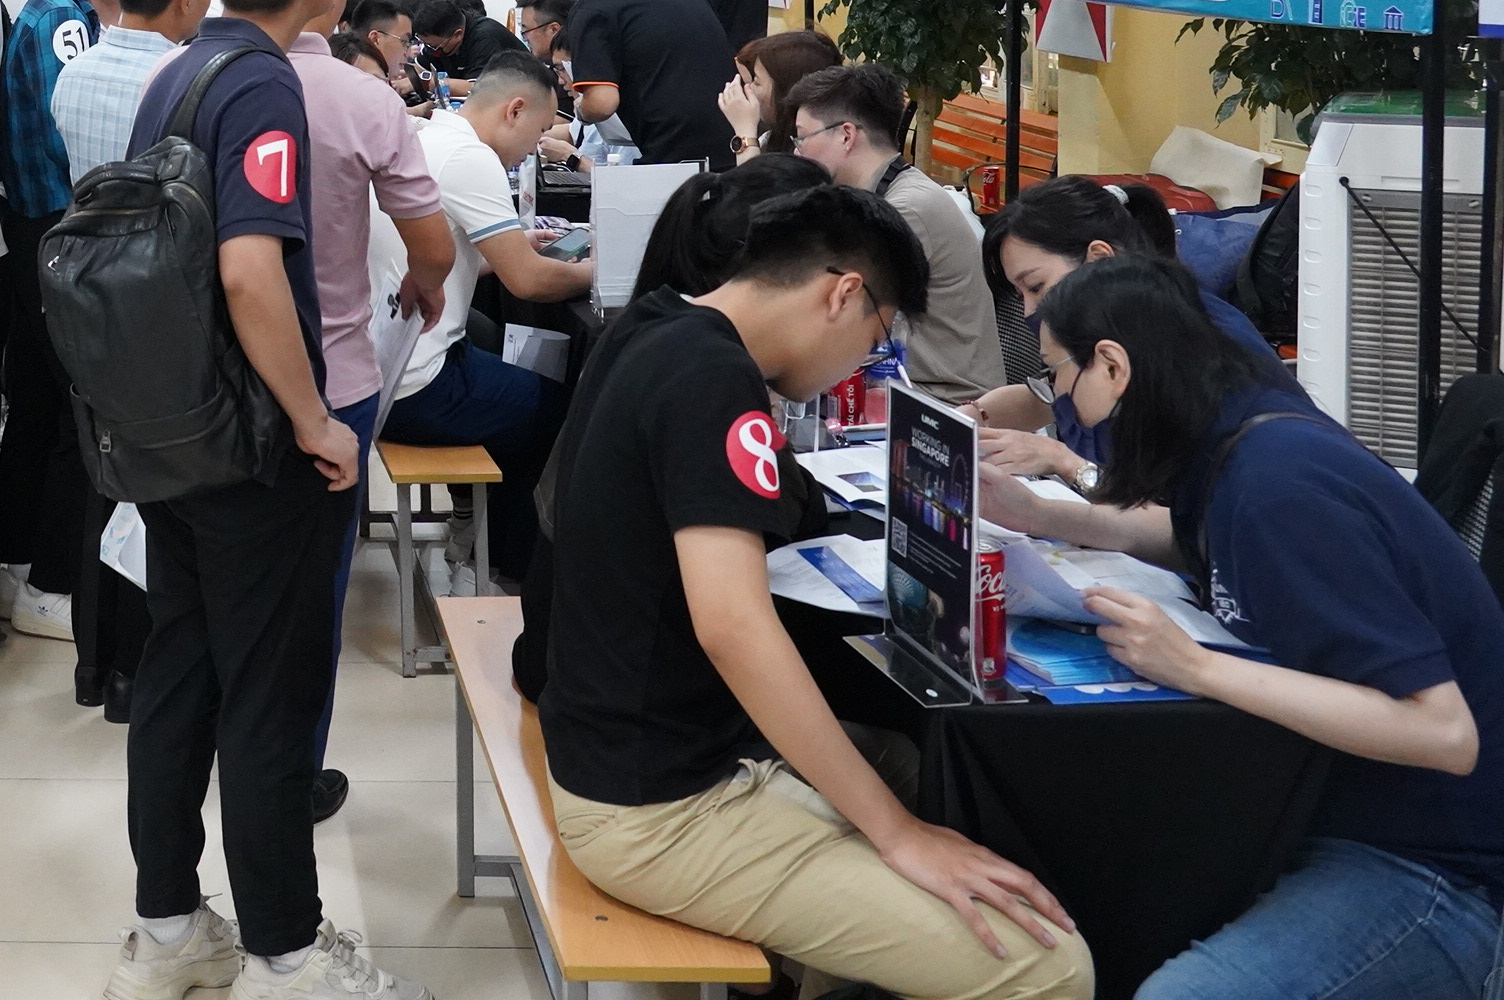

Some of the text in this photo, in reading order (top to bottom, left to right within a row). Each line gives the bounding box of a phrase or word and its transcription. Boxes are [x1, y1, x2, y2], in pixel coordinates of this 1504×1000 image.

[256, 139, 288, 197] 7
[738, 418, 780, 491] 8
[912, 436, 949, 467] SINGAPORE
